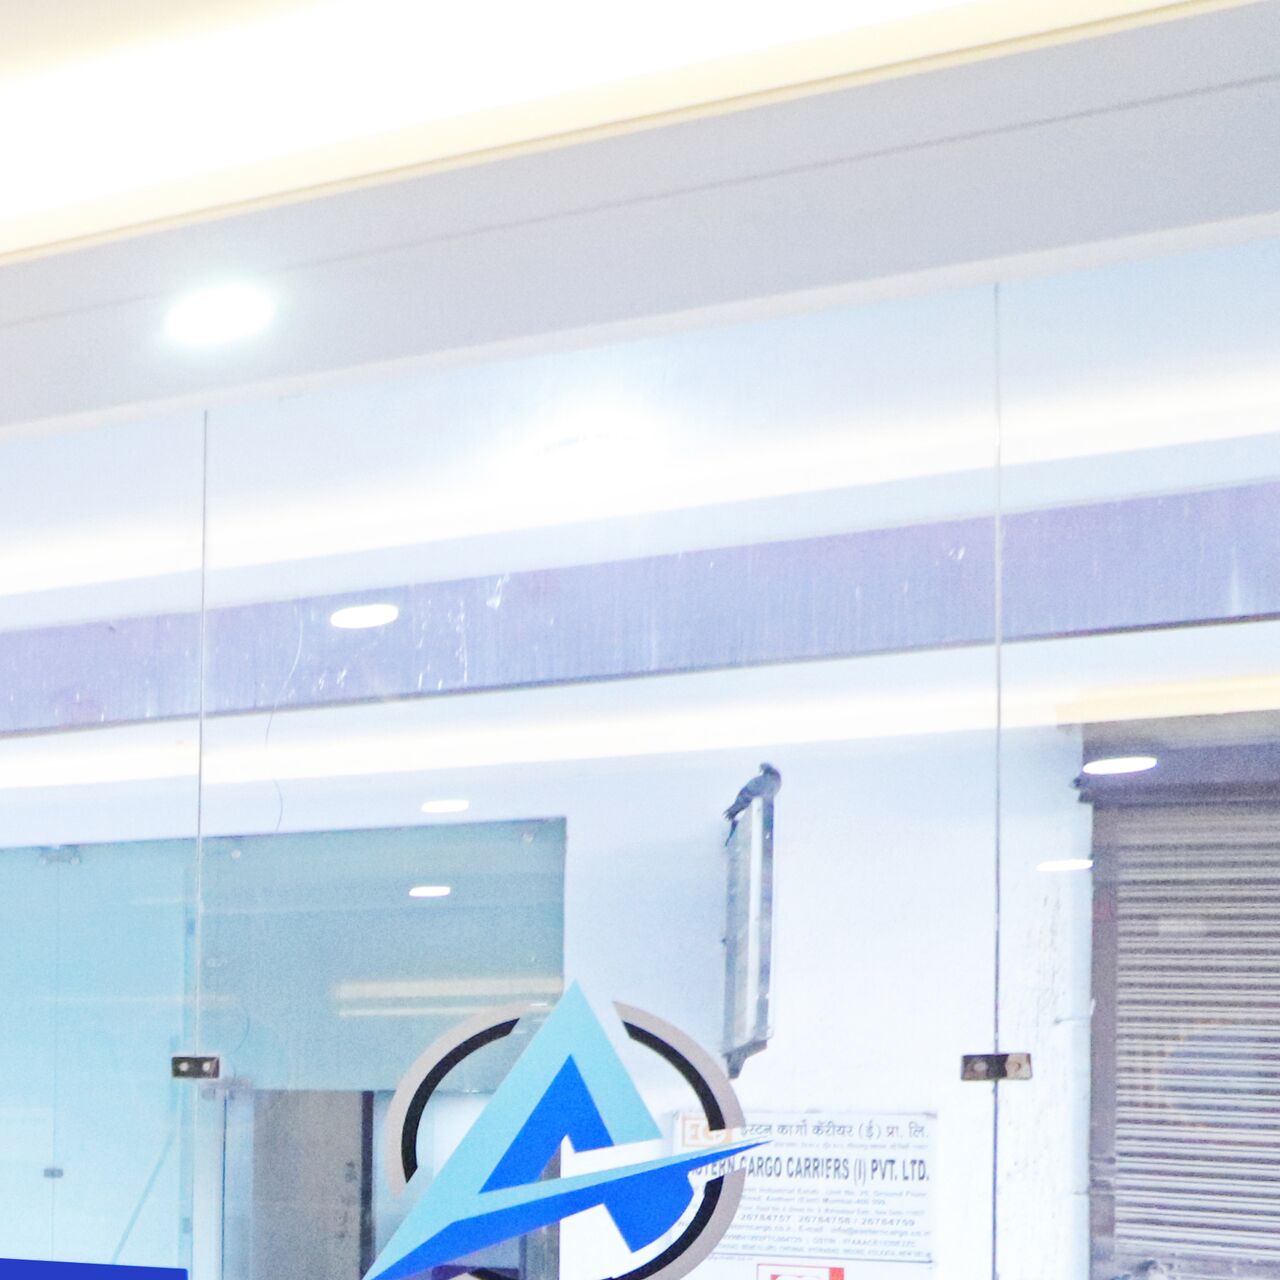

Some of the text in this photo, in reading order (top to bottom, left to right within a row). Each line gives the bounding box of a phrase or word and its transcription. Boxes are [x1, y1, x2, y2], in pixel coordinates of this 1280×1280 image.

[740, 1156, 782, 1178] CARGO
[787, 1157, 849, 1180] CARRIERS
[870, 1159, 897, 1181] PVT.
[903, 1160, 929, 1182] LTD.
